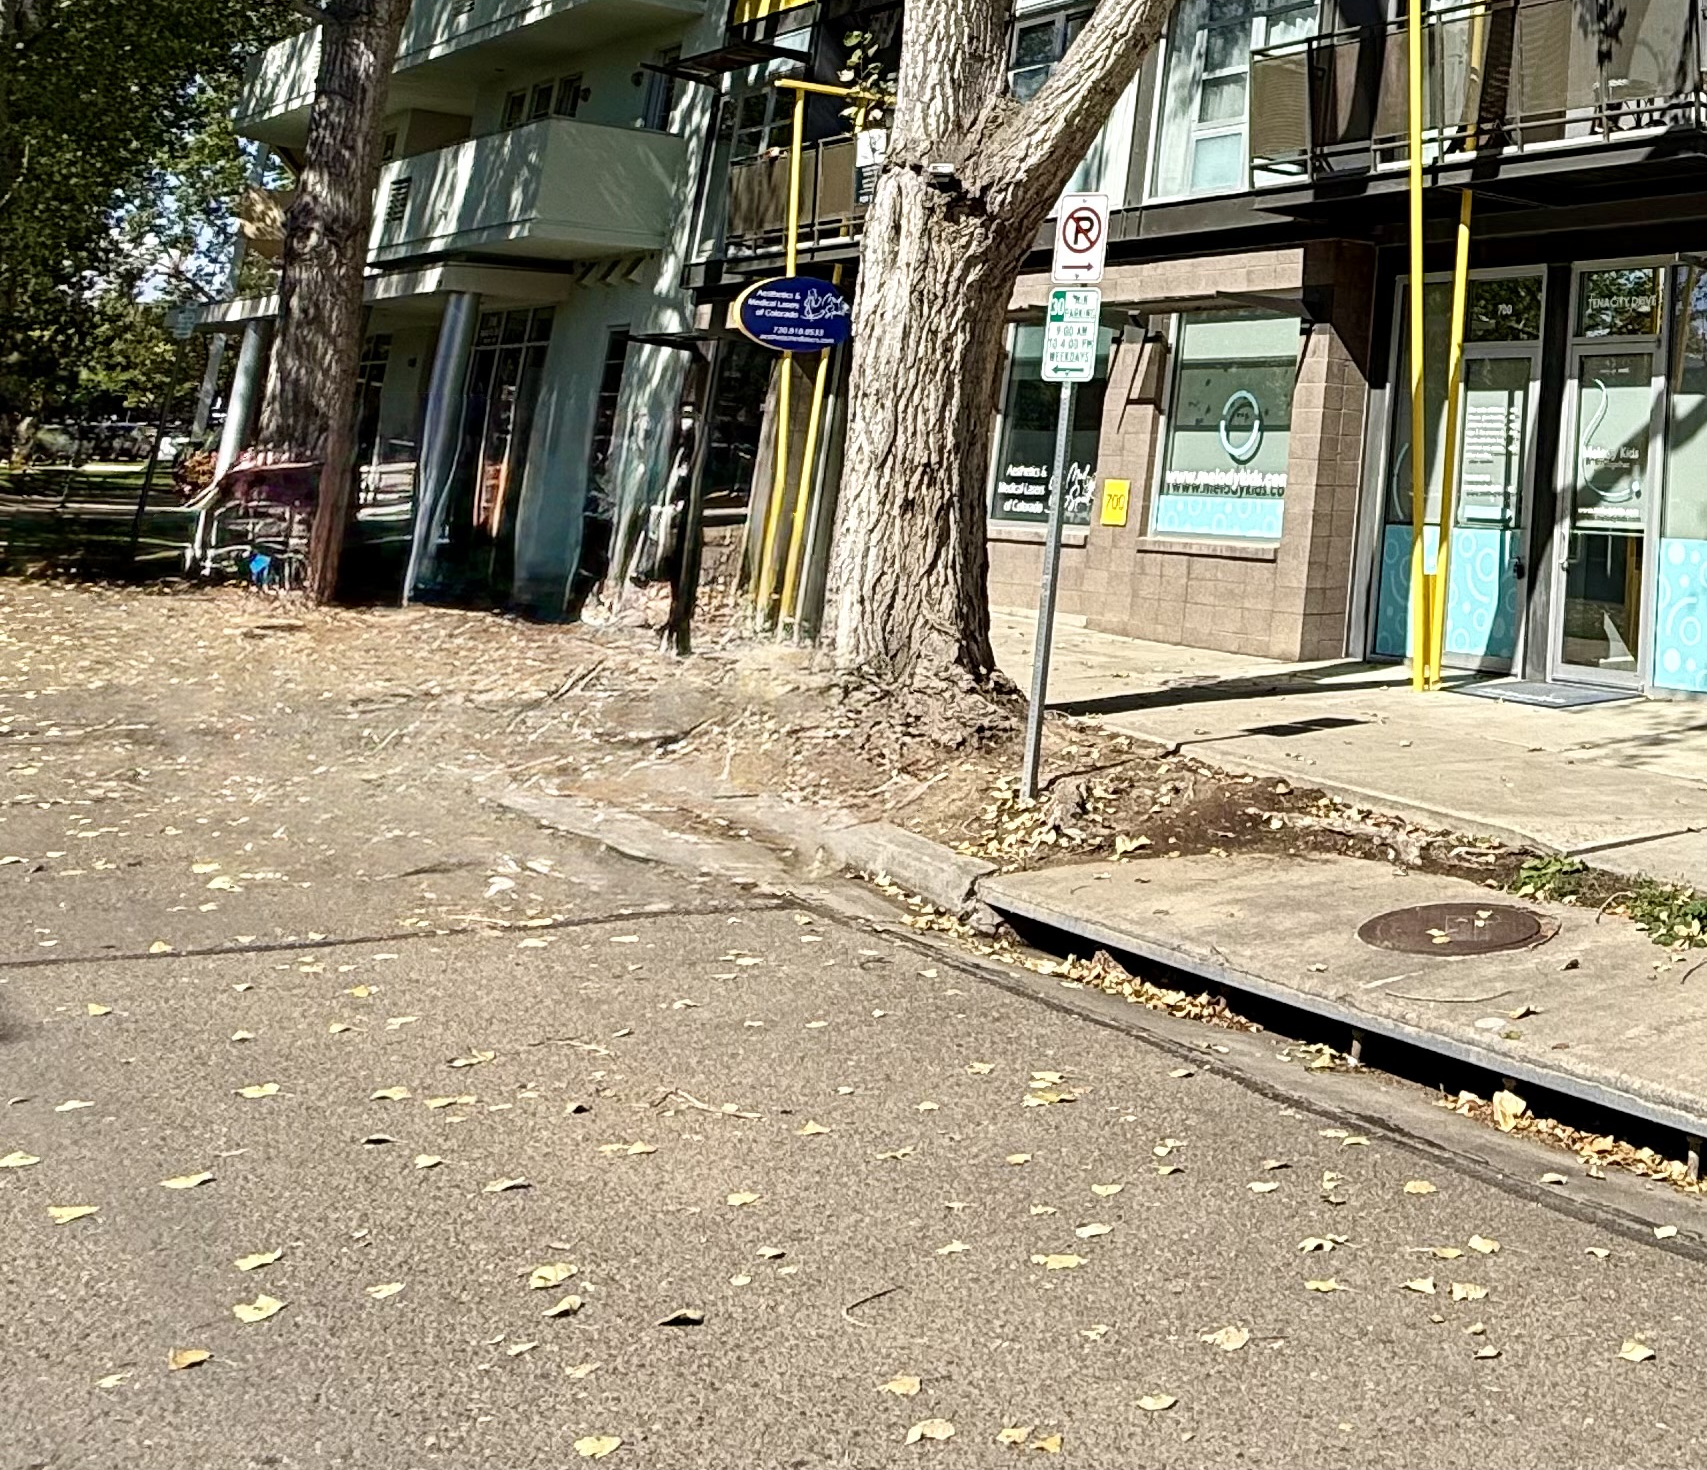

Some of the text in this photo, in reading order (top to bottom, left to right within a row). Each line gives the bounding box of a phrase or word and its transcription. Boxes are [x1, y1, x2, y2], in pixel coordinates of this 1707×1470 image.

[795, 292, 801, 300] &
[748, 298, 776, 307] Medical
[1050, 297, 1065, 316] 30
[765, 309, 799, 318] Colorado
[1065, 308, 1096, 320] PARKING
[1498, 304, 1513, 315] 700
[1077, 326, 1088, 336] AM
[1049, 338, 1058, 350] TO
[1082, 338, 1094, 349] PM
[1049, 351, 1090, 363] WEEKDAYS
[1620, 446, 1640, 459] Kids
[1006, 464, 1048, 478] Aesthetics &
[997, 481, 1024, 494] Medical
[1003, 499, 1044, 514] of Colorado
[1105, 493, 1126, 511] 700
